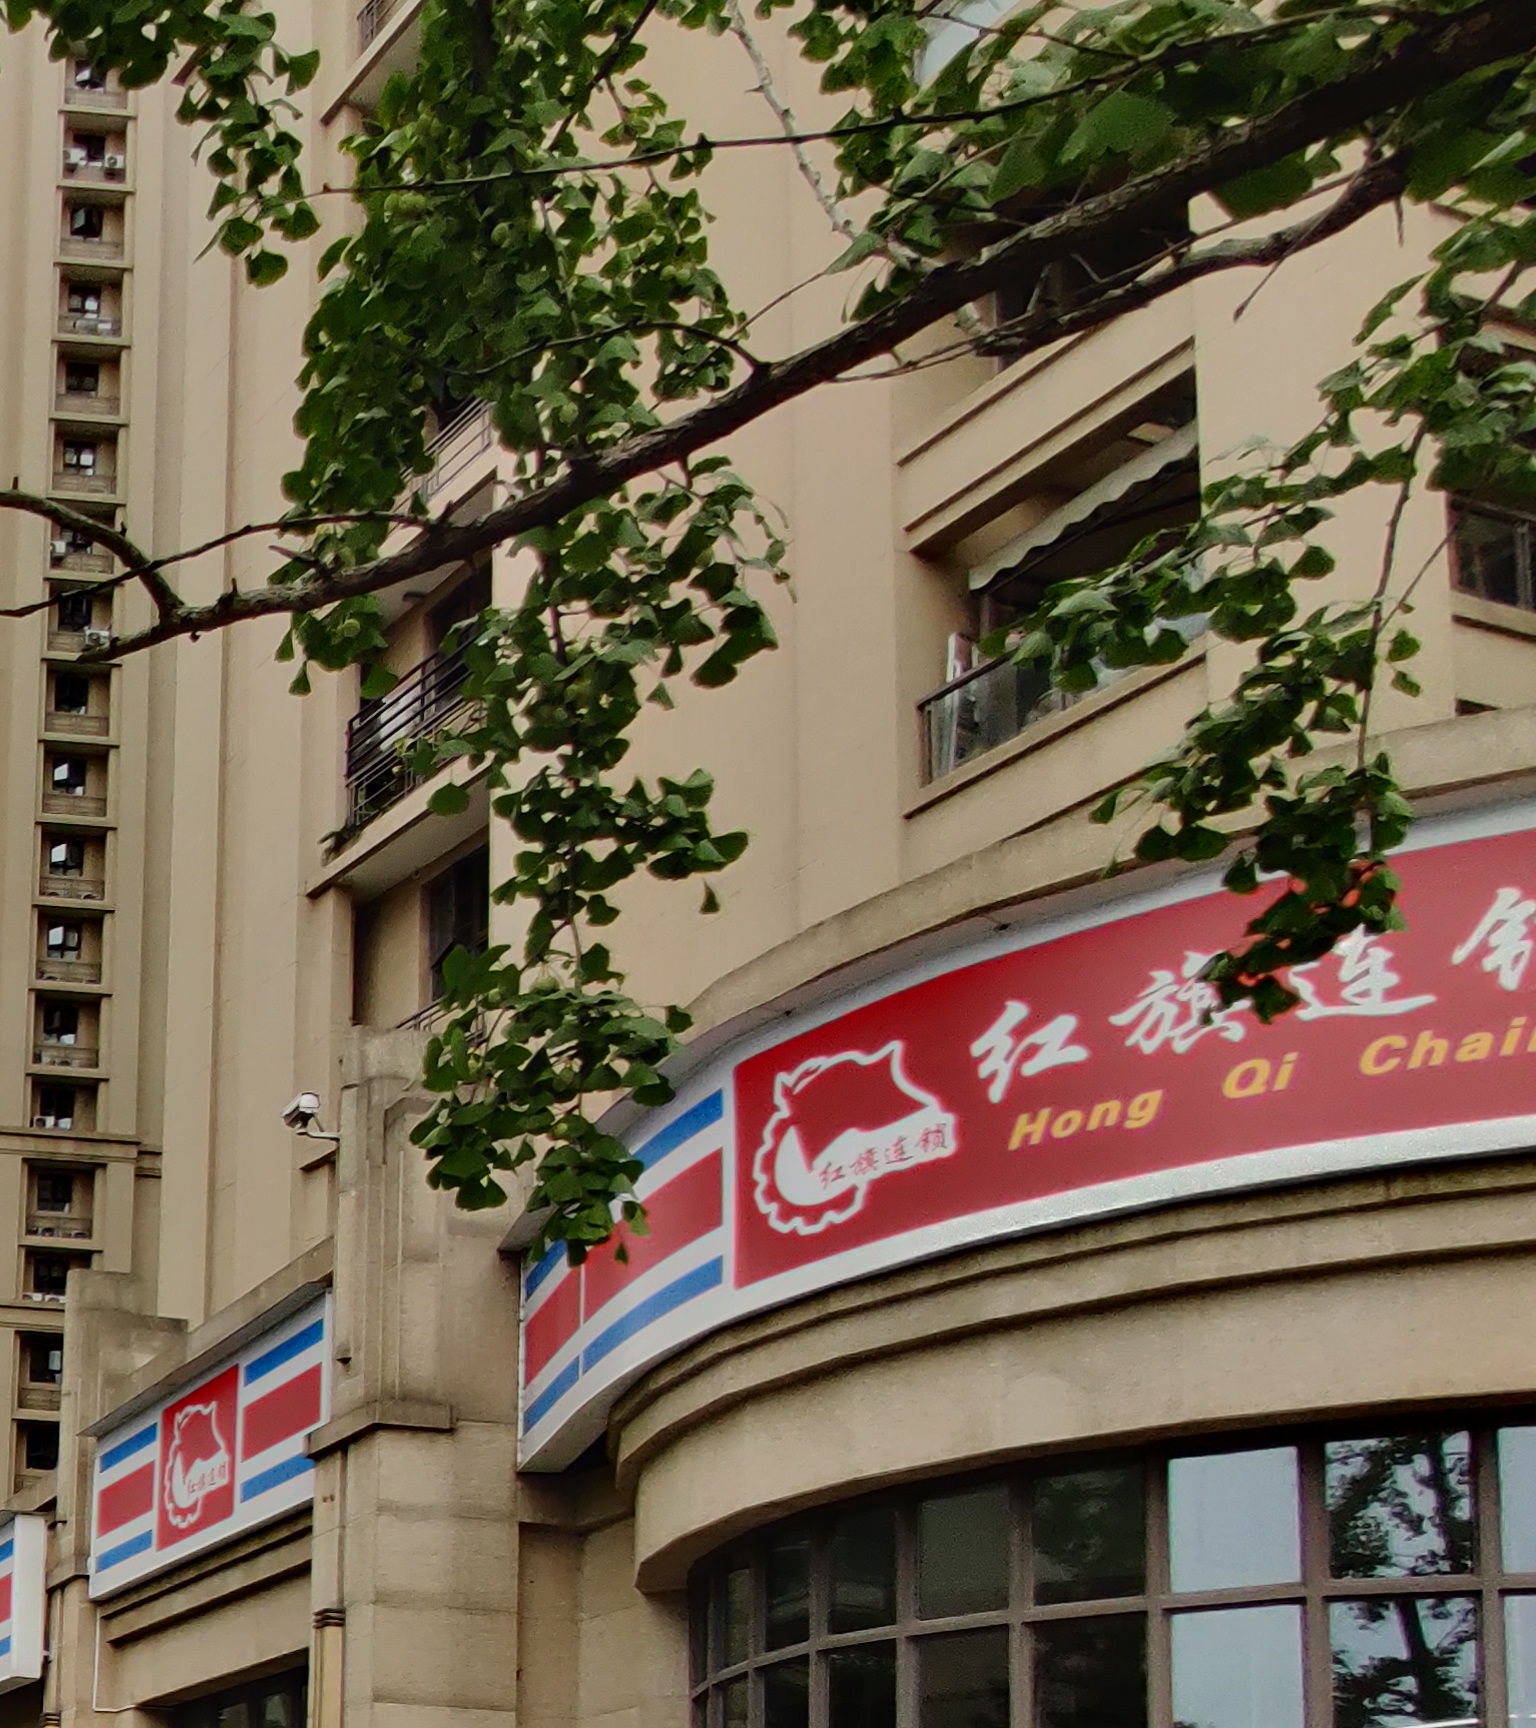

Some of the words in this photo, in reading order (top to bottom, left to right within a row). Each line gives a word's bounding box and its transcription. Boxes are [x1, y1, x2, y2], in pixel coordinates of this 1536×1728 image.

[1007, 1088, 1165, 1152] Hong
[1222, 1051, 1300, 1100] Qi
[1357, 1015, 1536, 1077] Chai
